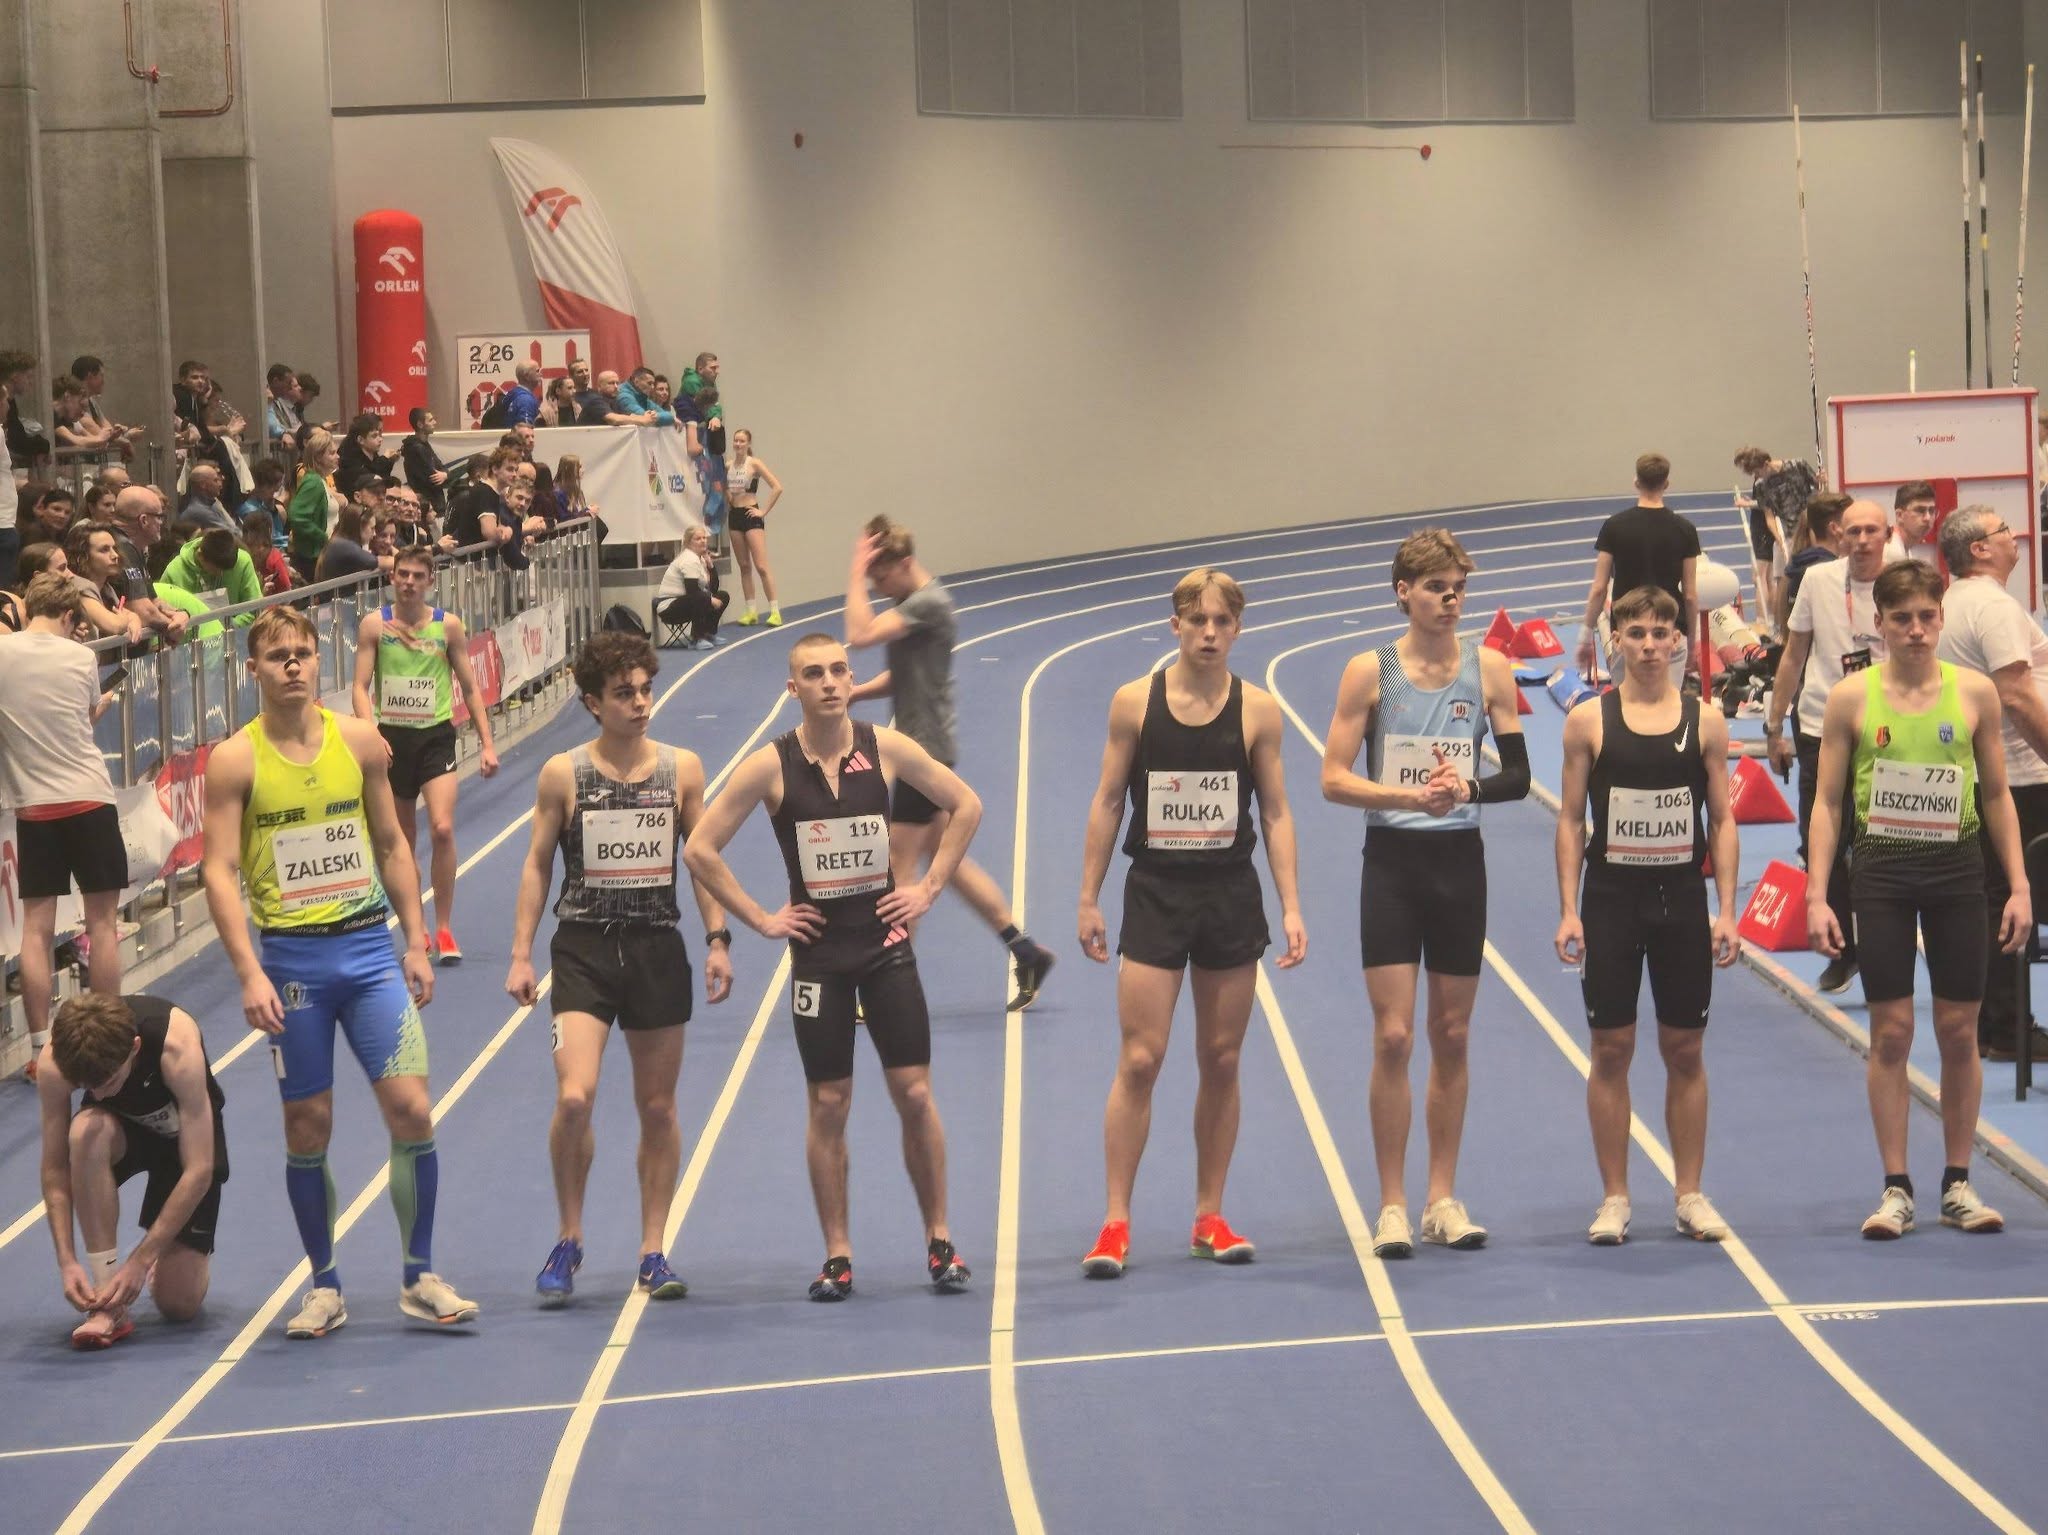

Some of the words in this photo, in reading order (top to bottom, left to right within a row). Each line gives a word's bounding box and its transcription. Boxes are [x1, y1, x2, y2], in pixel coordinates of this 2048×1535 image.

[374, 280, 419, 293] ORLEN
[470, 363, 501, 374] PZLA
[408, 679, 435, 690] 1395
[387, 695, 429, 708] JAROSZ
[1199, 776, 1230, 791] 461
[1400, 767, 1431, 785] PIG
[1924, 767, 1957, 784] 773
[651, 789, 672, 798] KML
[1654, 791, 1691, 809] 1063
[1874, 789, 1958, 814] LESZCZYŃSKI
[635, 812, 666, 828] 786
[1162, 803, 1225, 821] RULKA
[325, 823, 357, 842] 862
[849, 821, 880, 838] 119
[1615, 819, 1687, 838] KIELJAN
[808, 836, 832, 844] ORLEN
[597, 841, 662, 860] BOSAK
[285, 851, 362, 881] ZALESKI
[816, 849, 874, 871] REETZ
[818, 886, 855, 897] RZESZÓW
[1747, 882, 1789, 929] PZLA
[798, 985, 812, 1012] 5
